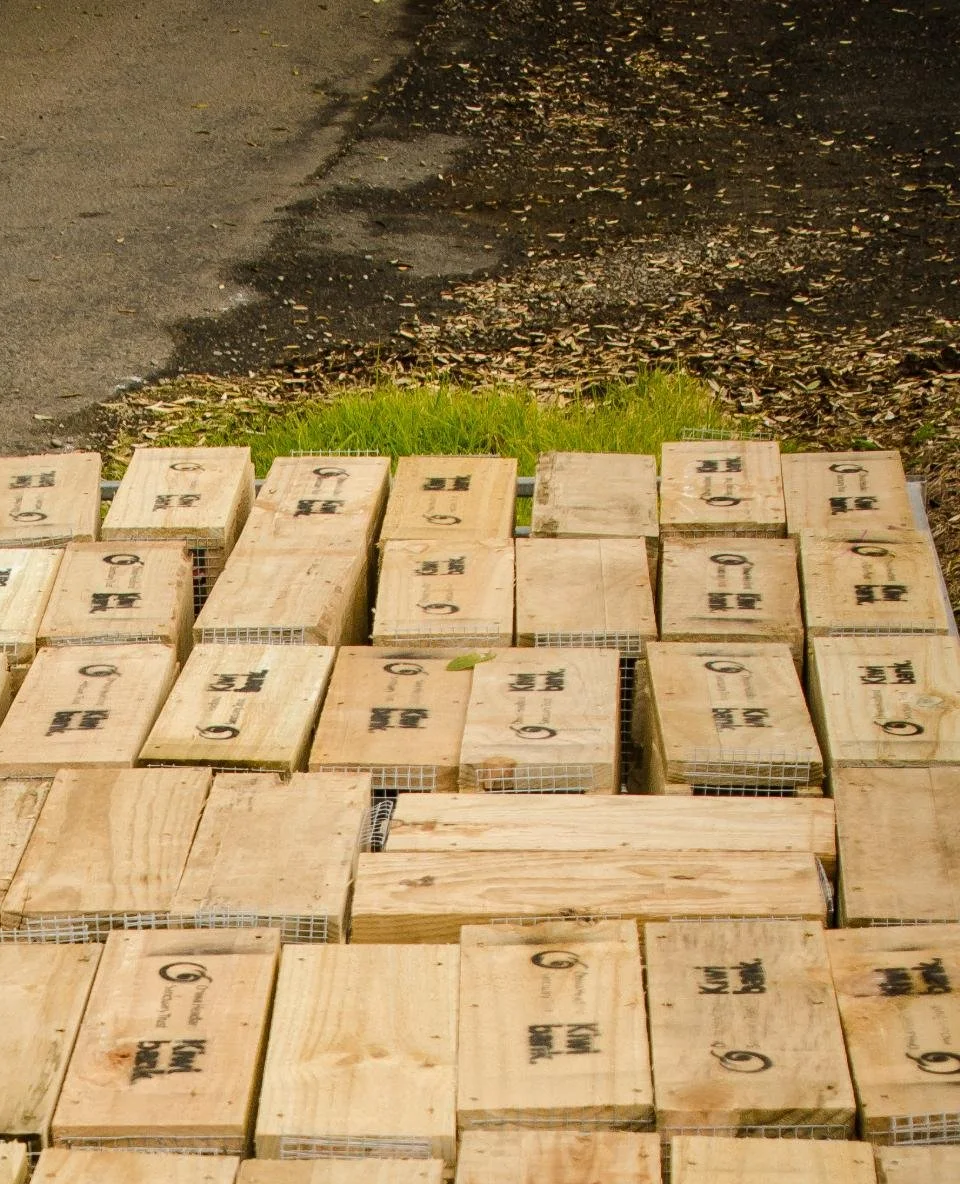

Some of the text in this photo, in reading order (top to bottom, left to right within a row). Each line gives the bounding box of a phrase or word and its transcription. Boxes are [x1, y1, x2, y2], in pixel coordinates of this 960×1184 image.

[205, 674, 237, 692] Kiwi
[694, 966, 730, 994] Kiwi
[566, 1023, 601, 1054] Kiwi
[167, 1039, 208, 1074] Kiwi
